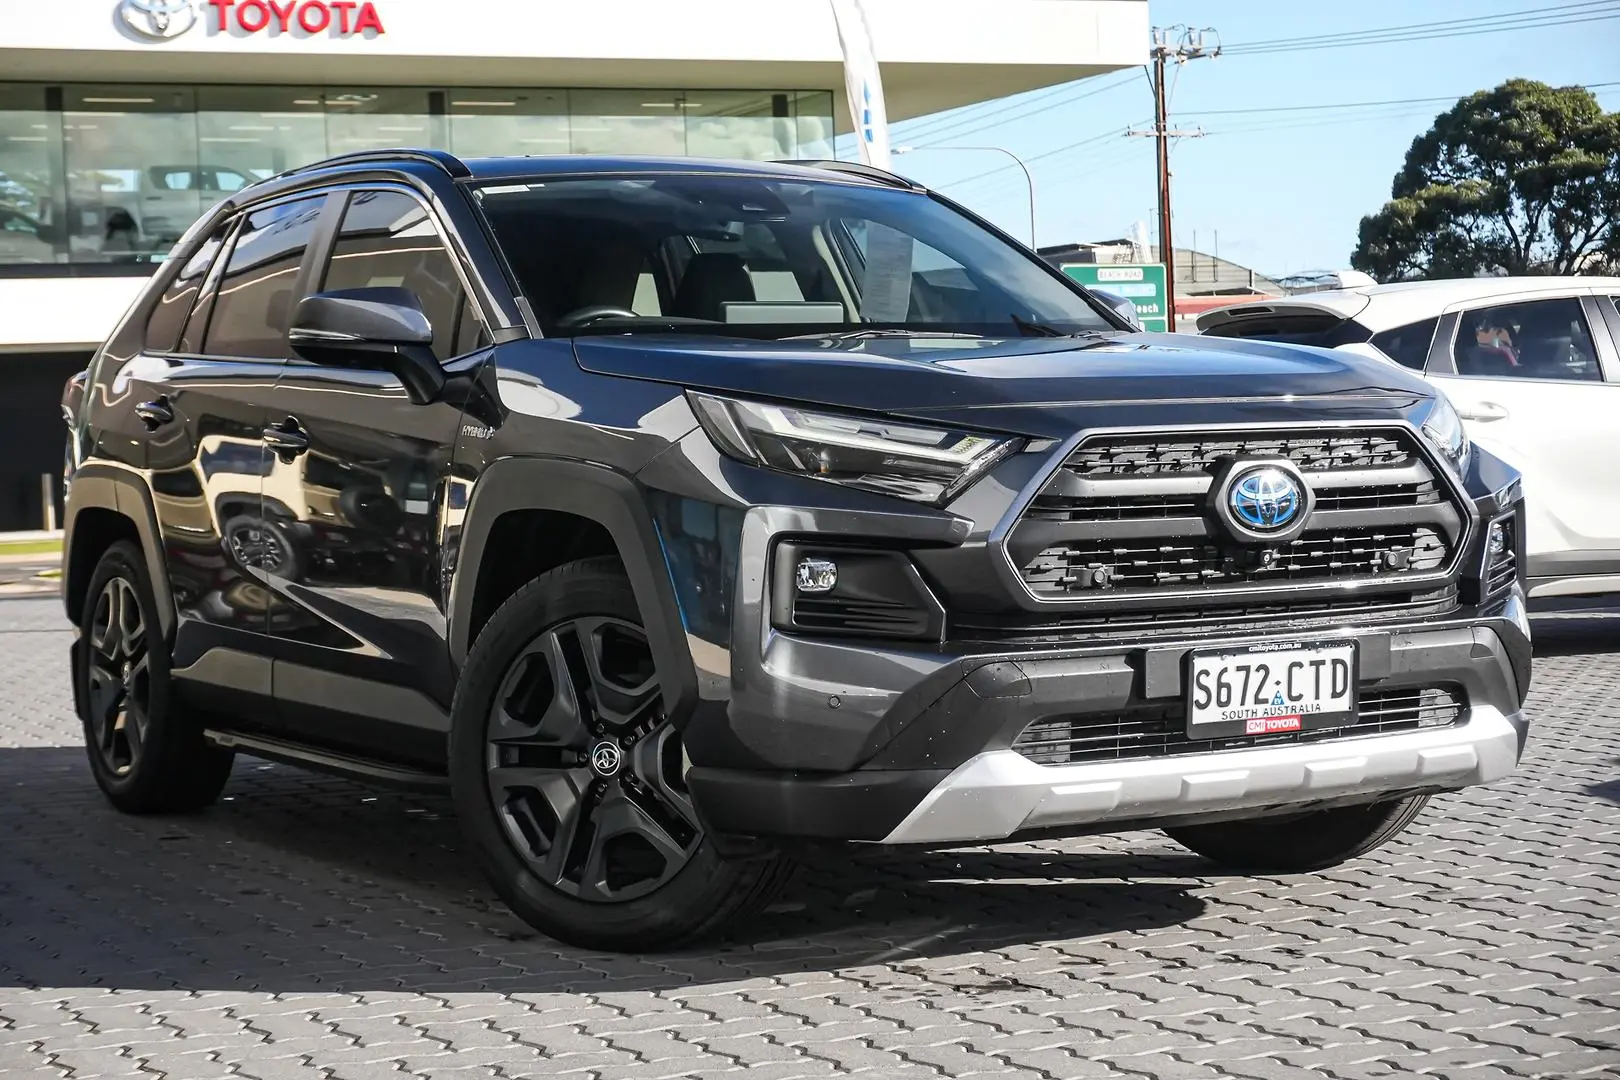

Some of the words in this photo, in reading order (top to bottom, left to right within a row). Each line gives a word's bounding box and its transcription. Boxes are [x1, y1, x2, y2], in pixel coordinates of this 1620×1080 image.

[208, 0, 385, 33] TOYOTA
[1136, 303, 1159, 313] each
[1222, 709, 1258, 720] SOUTH
[1263, 704, 1321, 717] AUSTRALIA
[1266, 718, 1299, 729] TOYOTA
